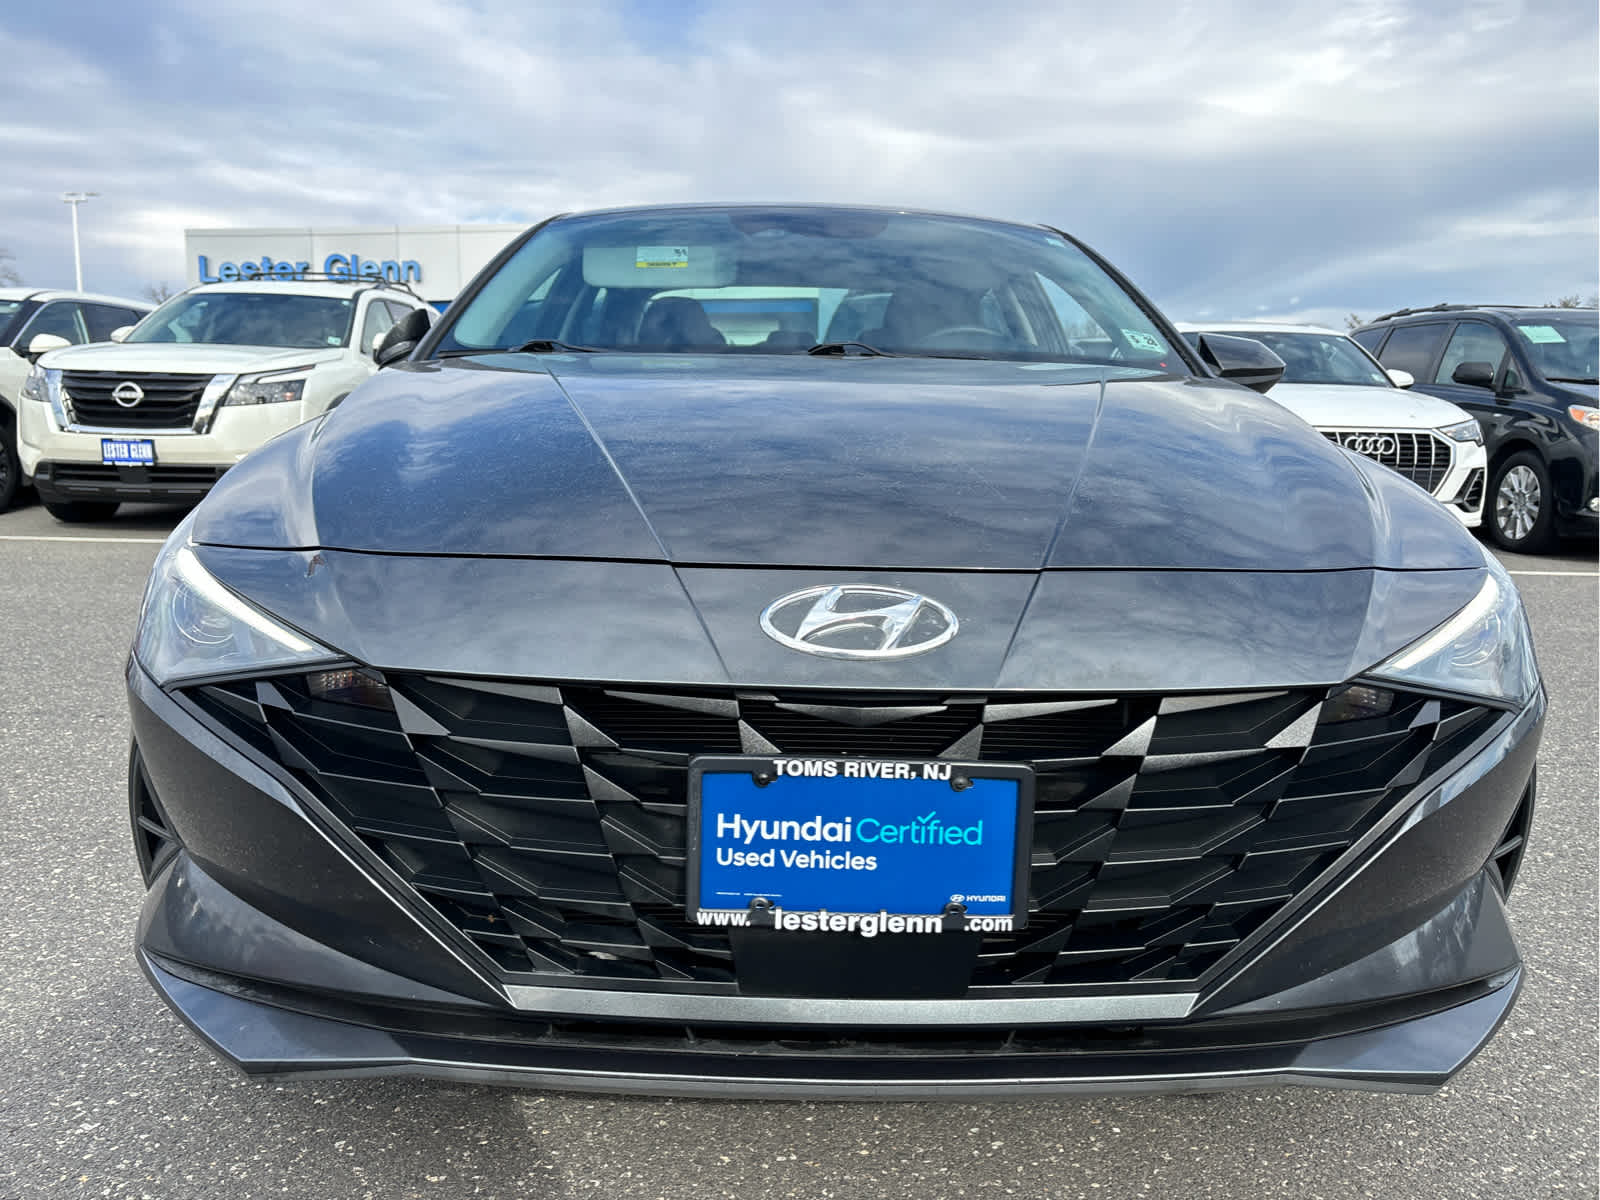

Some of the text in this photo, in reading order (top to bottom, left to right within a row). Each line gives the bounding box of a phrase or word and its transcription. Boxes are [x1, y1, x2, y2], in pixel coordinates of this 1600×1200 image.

[198, 253, 421, 284] Lester Glenn
[773, 759, 952, 781] TOMS RIVER, NJ
[716, 811, 984, 846] Hyundai Certified
[716, 847, 878, 871] Used Vehicles
[965, 895, 1007, 903] HYUNDAI
[696, 907, 1014, 938] www. lesterglenn .com
